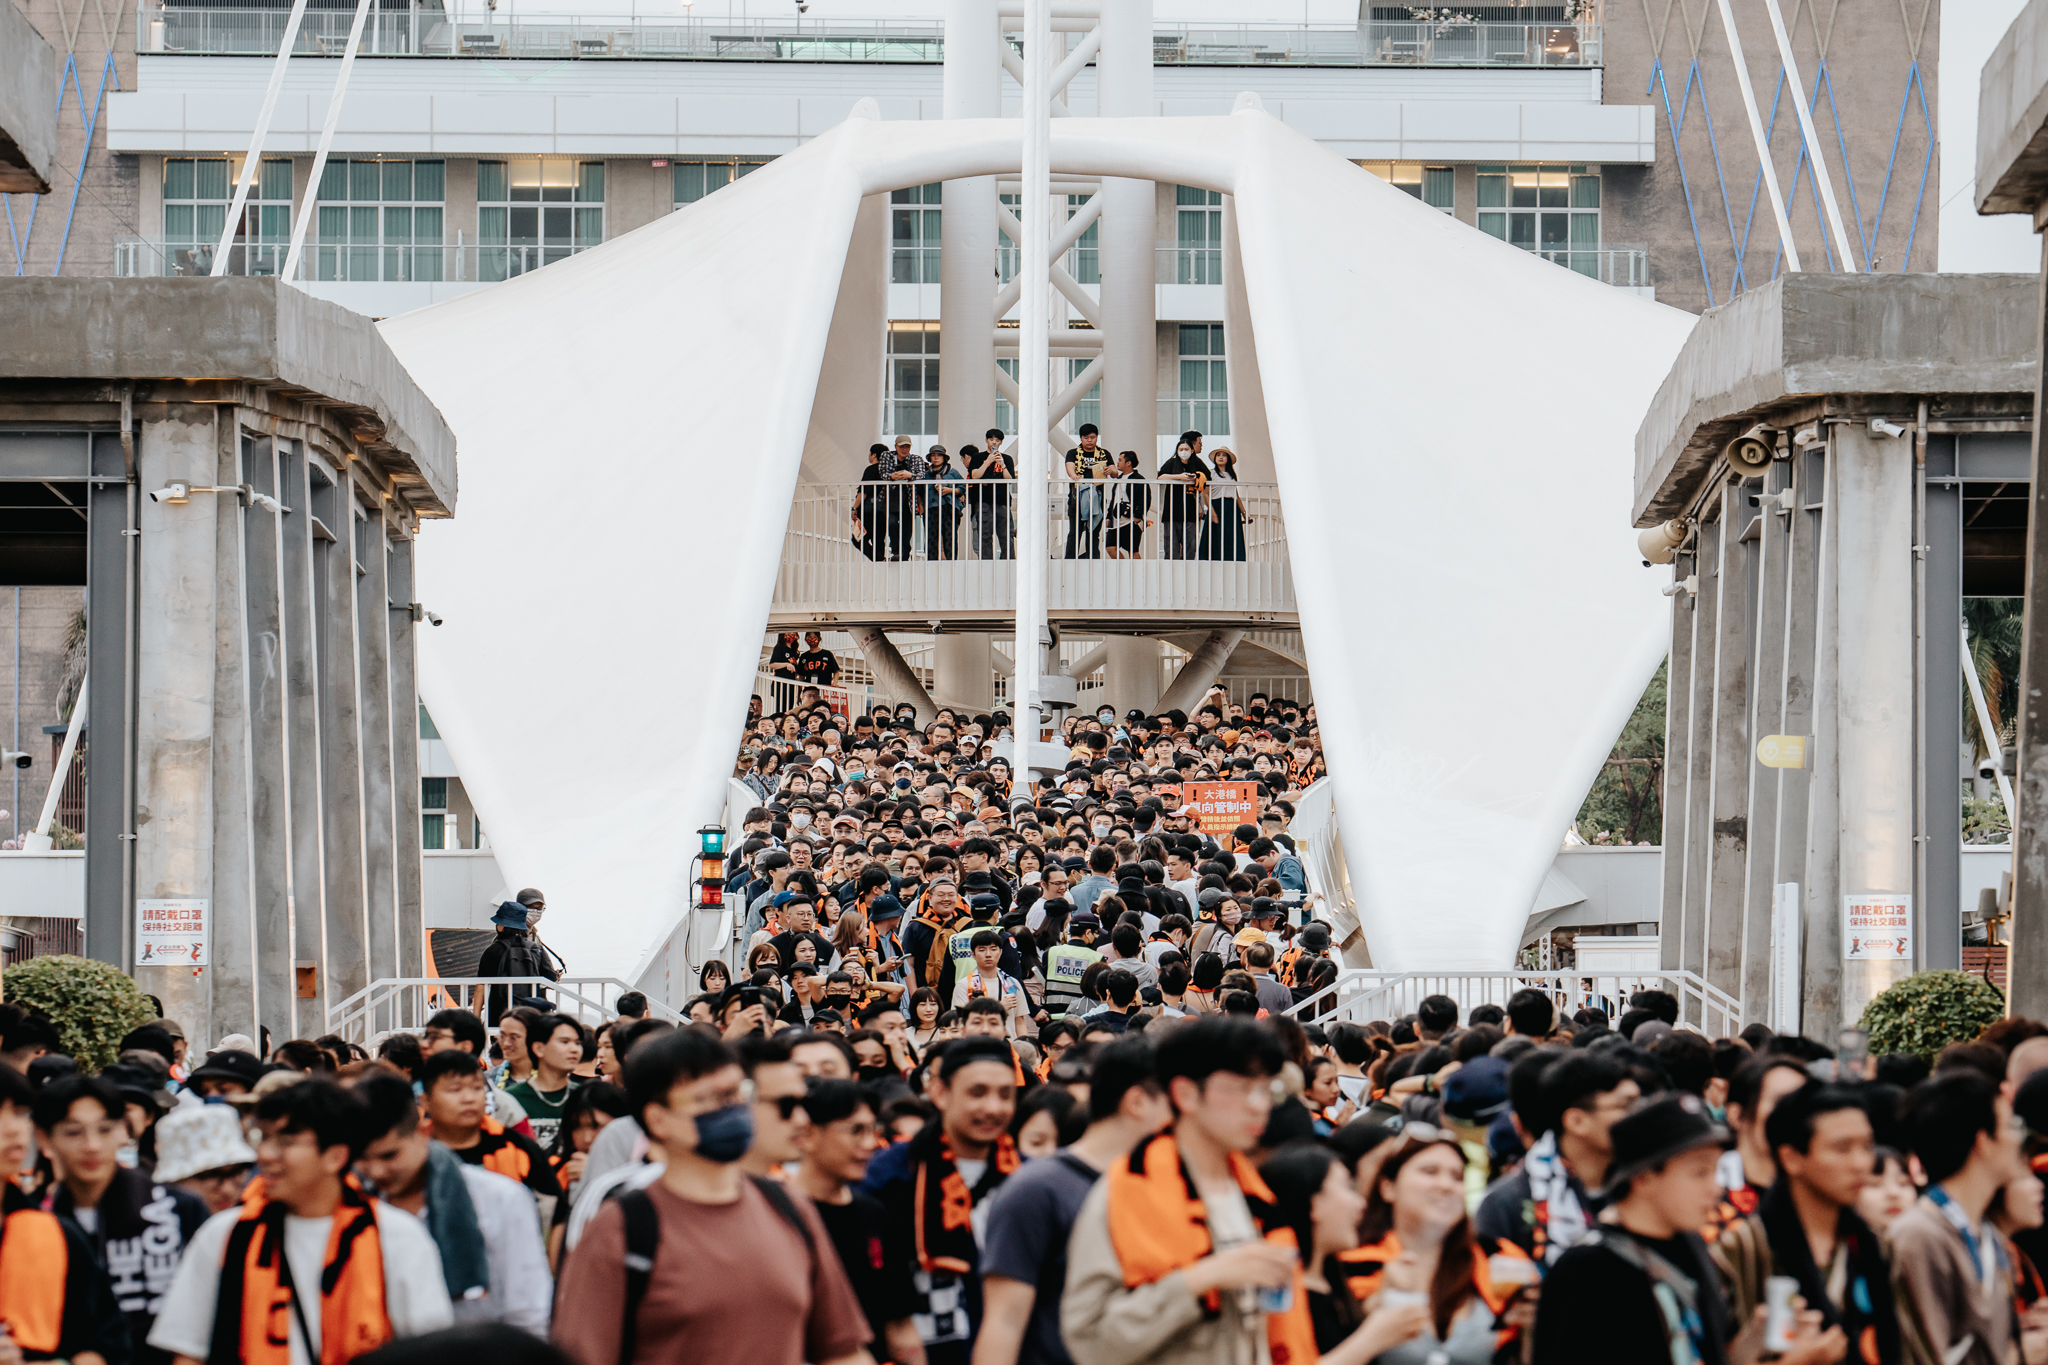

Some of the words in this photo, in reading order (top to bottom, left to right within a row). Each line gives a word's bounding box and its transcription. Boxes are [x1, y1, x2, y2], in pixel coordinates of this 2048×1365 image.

[1204, 789, 1236, 799] 大港橋
[1190, 801, 1252, 813] 單向管制中
[143, 910, 202, 920] 請配戴口罩
[1850, 905, 1906, 915] 請配戴口罩
[142, 922, 203, 931] 保持社交距離
[1850, 918, 1907, 926] 保持社交距離
